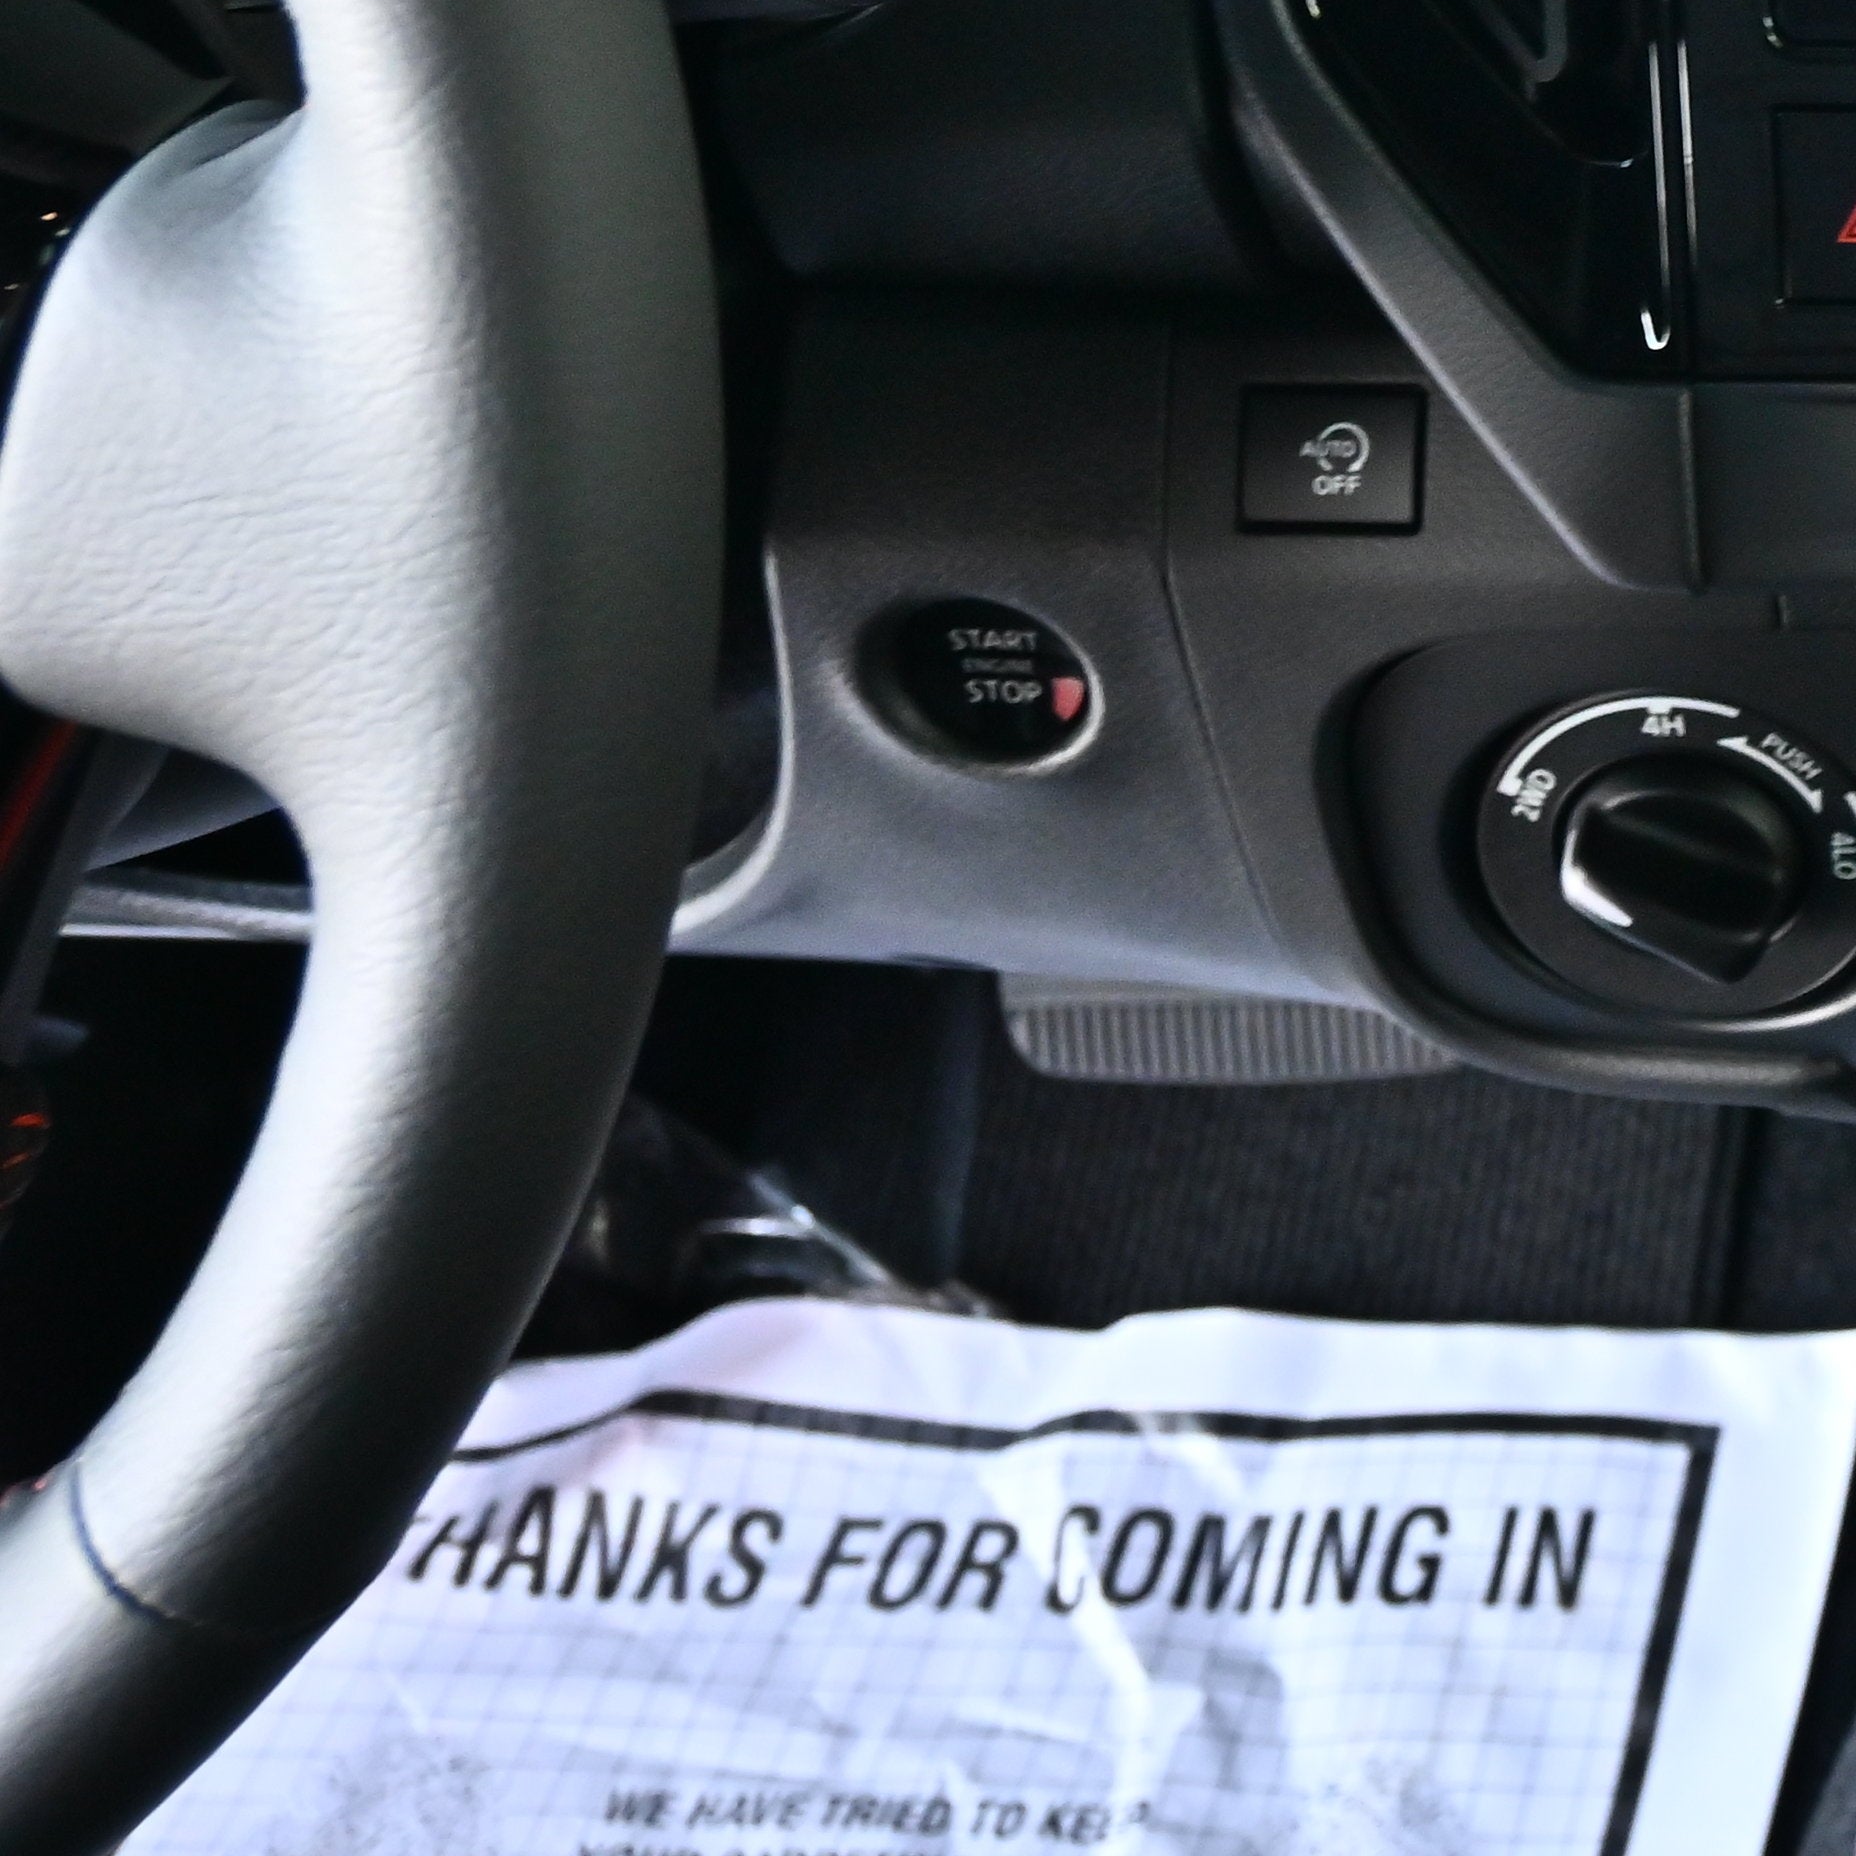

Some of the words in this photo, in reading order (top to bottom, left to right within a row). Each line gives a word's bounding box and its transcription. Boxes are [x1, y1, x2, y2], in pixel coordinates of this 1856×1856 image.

[1311, 475, 1362, 497] OFF
[947, 629, 1038, 652] START
[964, 678, 1042, 704] STOP
[1640, 714, 1688, 738] 4H
[1759, 732, 1823, 781] PUSH
[400, 1485, 785, 1609] HANKS
[797, 1515, 1019, 1614] FOR
[1045, 1504, 1451, 1616] COMING
[1483, 1506, 1597, 1612] IN
